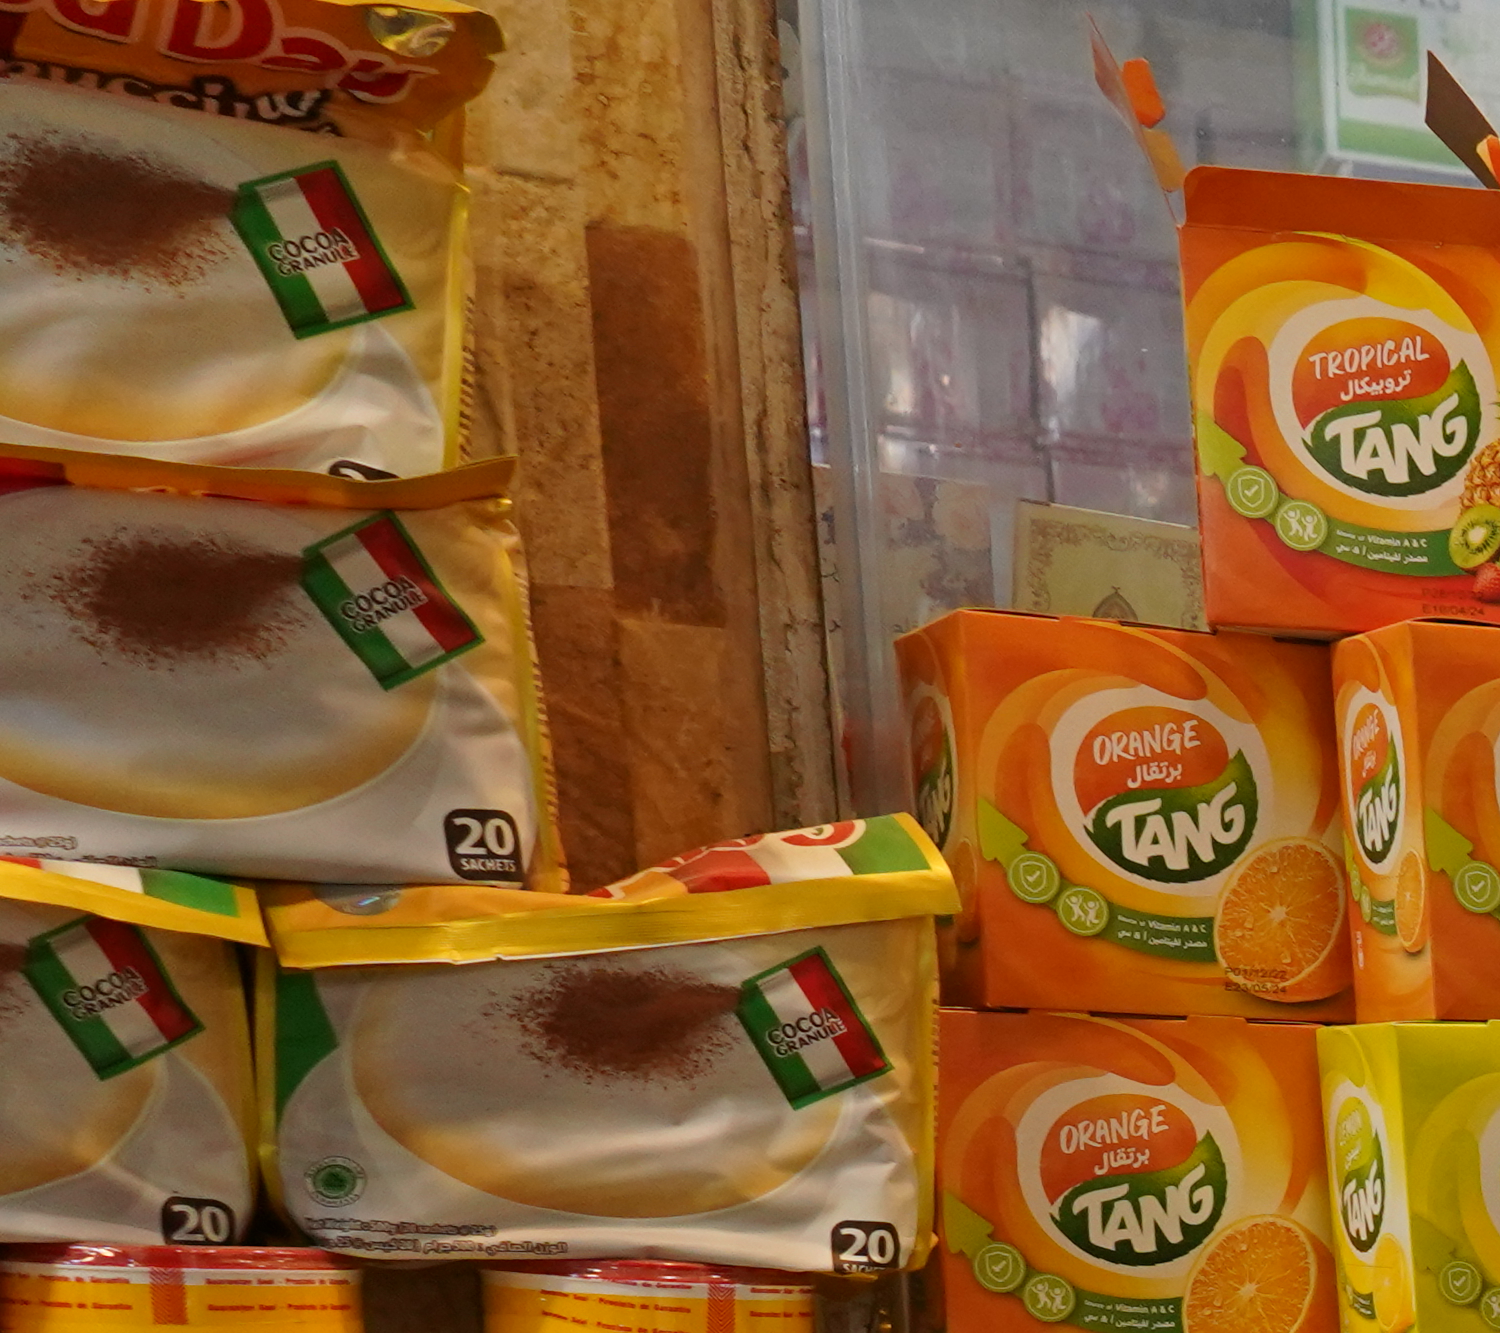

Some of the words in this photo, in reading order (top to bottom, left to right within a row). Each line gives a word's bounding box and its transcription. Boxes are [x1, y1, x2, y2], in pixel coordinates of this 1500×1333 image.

[268, 228, 349, 263] COCOA
[277, 245, 357, 276] GRANULE
[1309, 336, 1431, 380] TROPICAL
[1340, 367, 1413, 401] تروبيكال
[1323, 394, 1468, 484] TANG
[341, 579, 417, 620] COCOA
[352, 593, 428, 634] GRANULE
[1093, 719, 1201, 765] ORANGE
[1126, 761, 1184, 790] برتقال
[1106, 781, 1247, 870] TANG
[1358, 763, 1398, 852] TANG
[453, 817, 516, 855] 20
[460, 857, 518, 874] SACHETS
[63, 966, 138, 1008] COCOA
[767, 1008, 838, 1045] COCOA
[774, 1021, 846, 1057] GRANULE
[1059, 1103, 1169, 1153] ORANGE
[1094, 1146, 1150, 1176] برتقال
[1072, 1163, 1214, 1253] TANG
[1343, 1160, 1383, 1241] TANG
[170, 1205, 231, 1242] 20
[838, 1228, 895, 1262] 20
